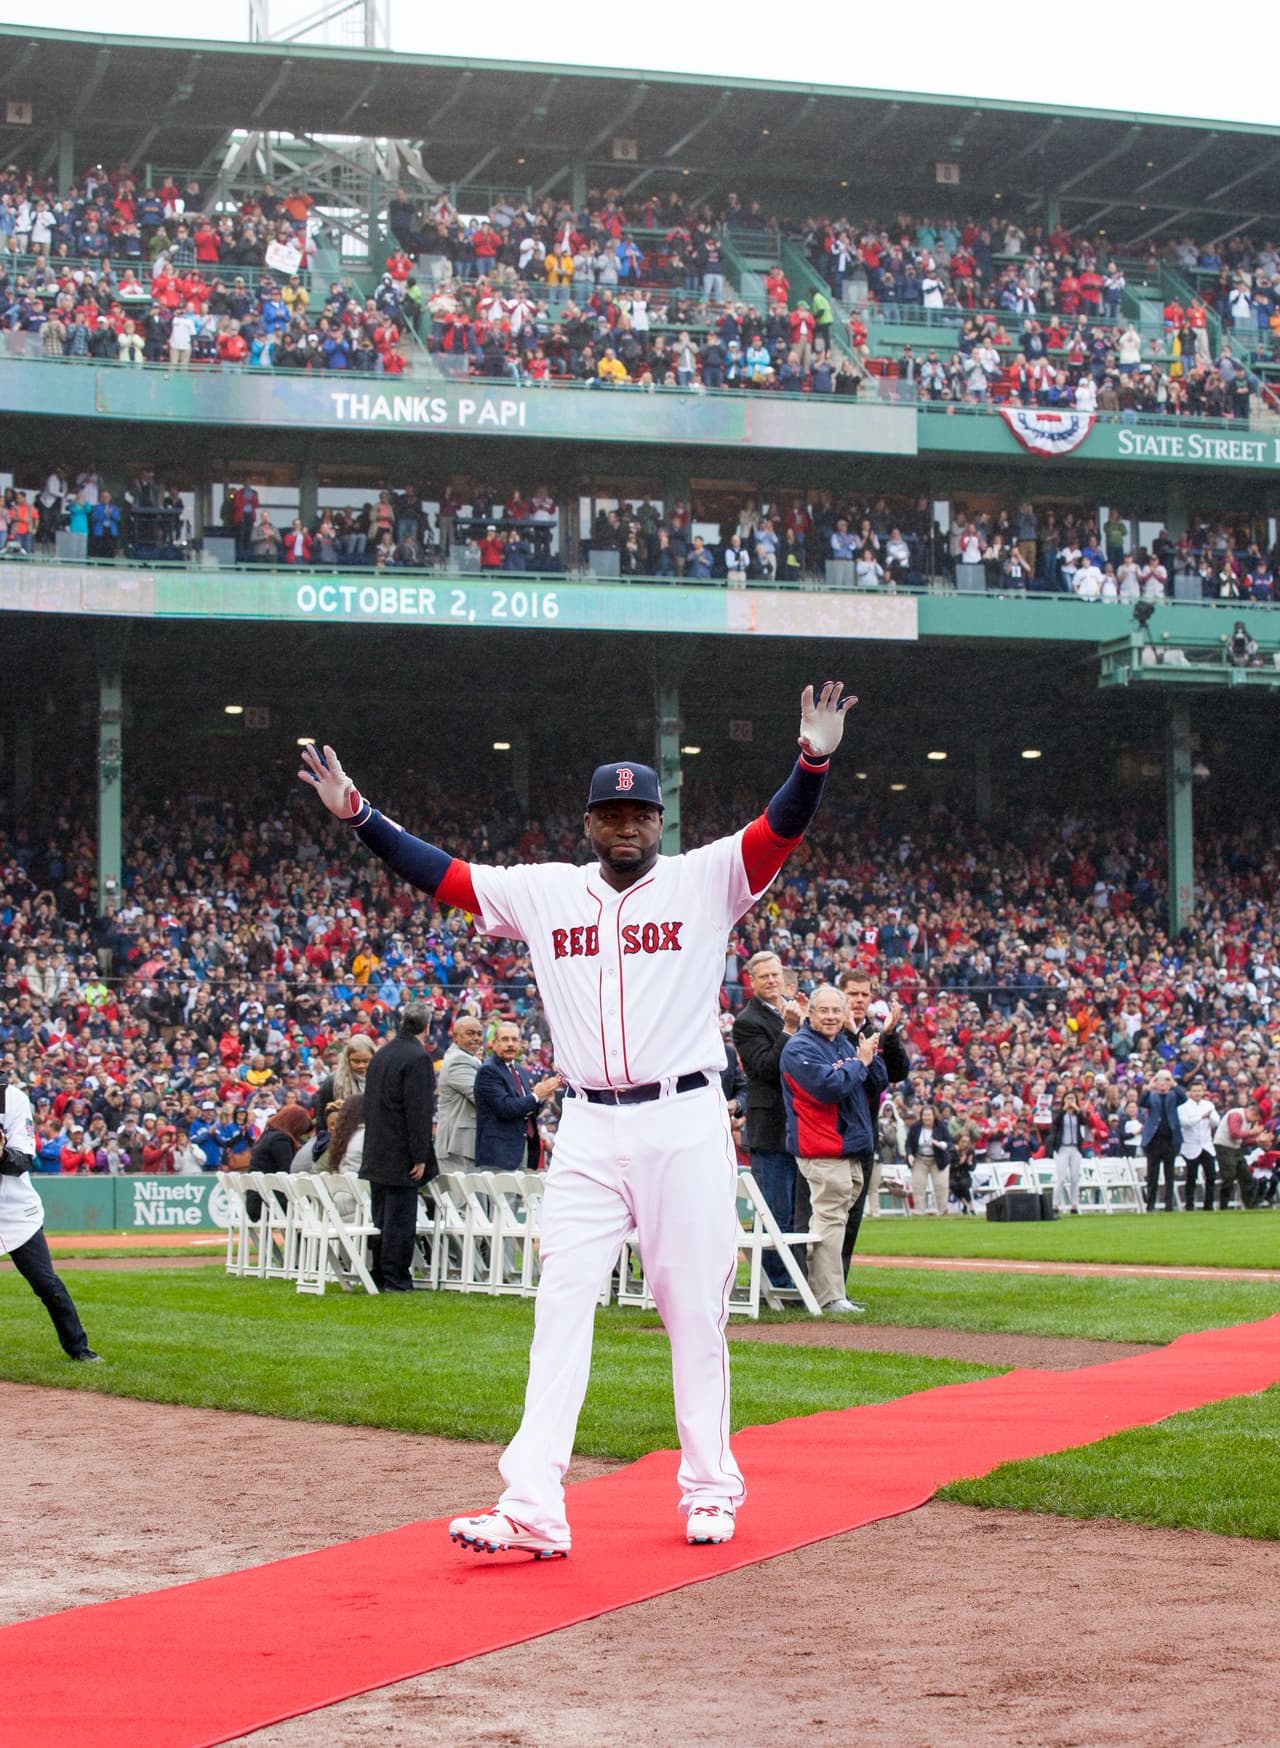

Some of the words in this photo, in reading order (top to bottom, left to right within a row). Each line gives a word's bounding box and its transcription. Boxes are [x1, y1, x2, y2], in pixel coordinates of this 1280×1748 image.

[331, 393, 448, 423] THANKS
[458, 399, 526, 427] PAPI
[1118, 429, 1185, 458] STATE
[1188, 433, 1267, 463] STREET
[297, 585, 436, 615] OCTOBER
[450, 589, 476, 622] 2,
[491, 590, 559, 618] 2016
[615, 768, 634, 791] B
[552, 925, 599, 960] RED
[621, 921, 683, 955] SOX
[133, 1181, 206, 1203] Ninety
[133, 1201, 202, 1226] Nine
